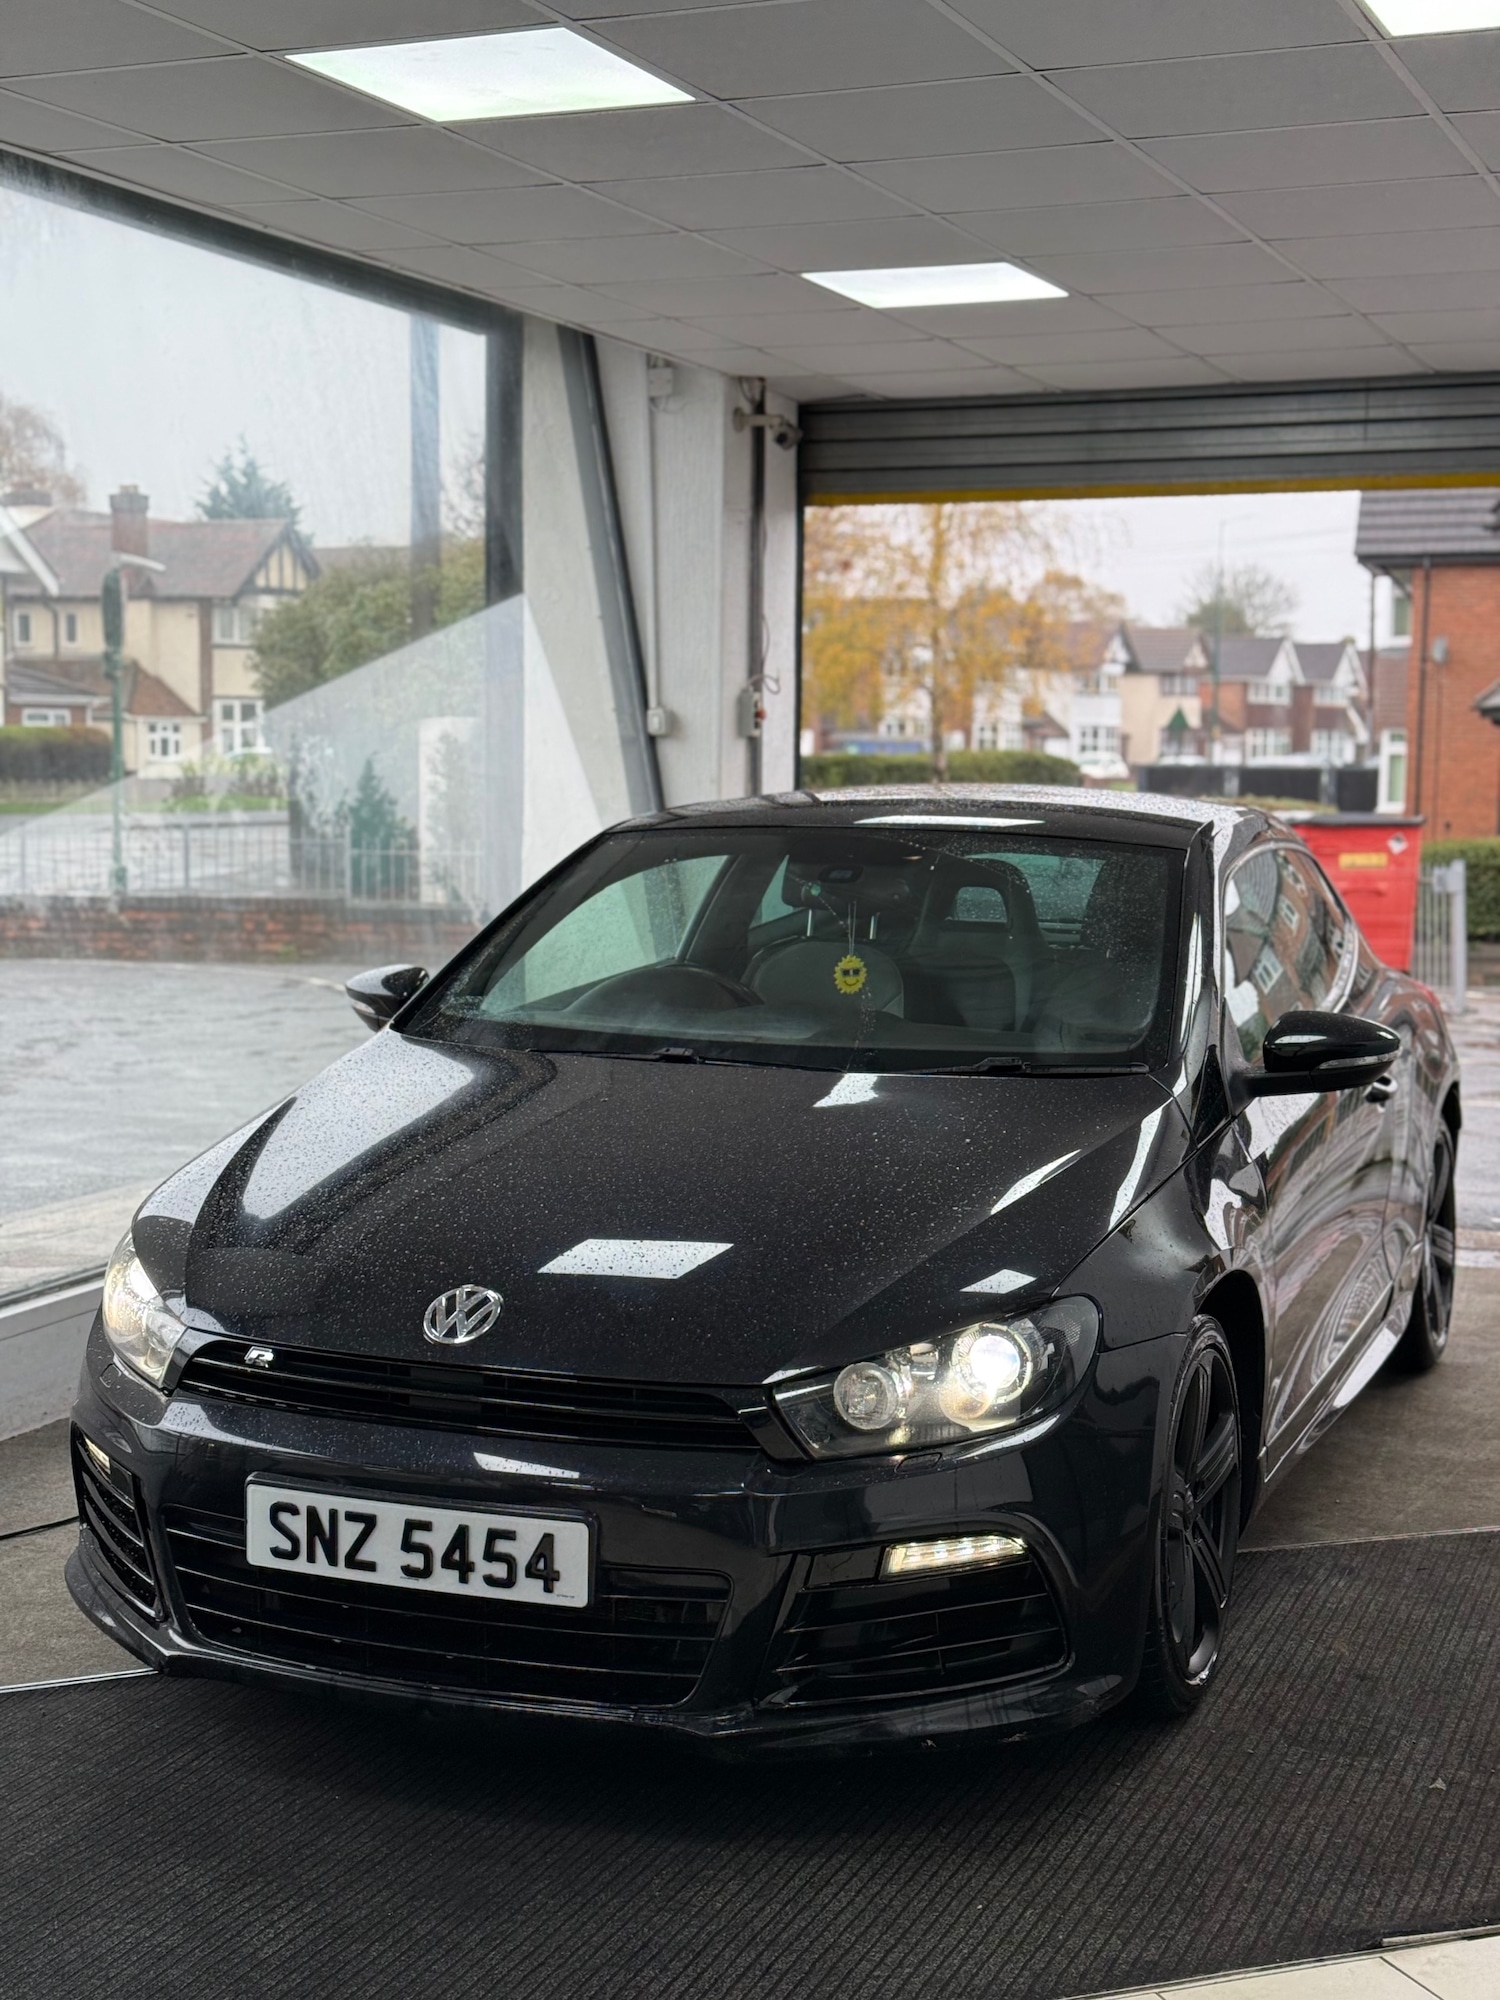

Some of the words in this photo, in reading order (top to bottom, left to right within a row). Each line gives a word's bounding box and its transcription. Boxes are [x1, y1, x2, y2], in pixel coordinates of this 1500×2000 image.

[244, 1346, 274, 1368] R
[269, 1501, 377, 1572] SNZ
[400, 1518, 560, 1594] 5454
